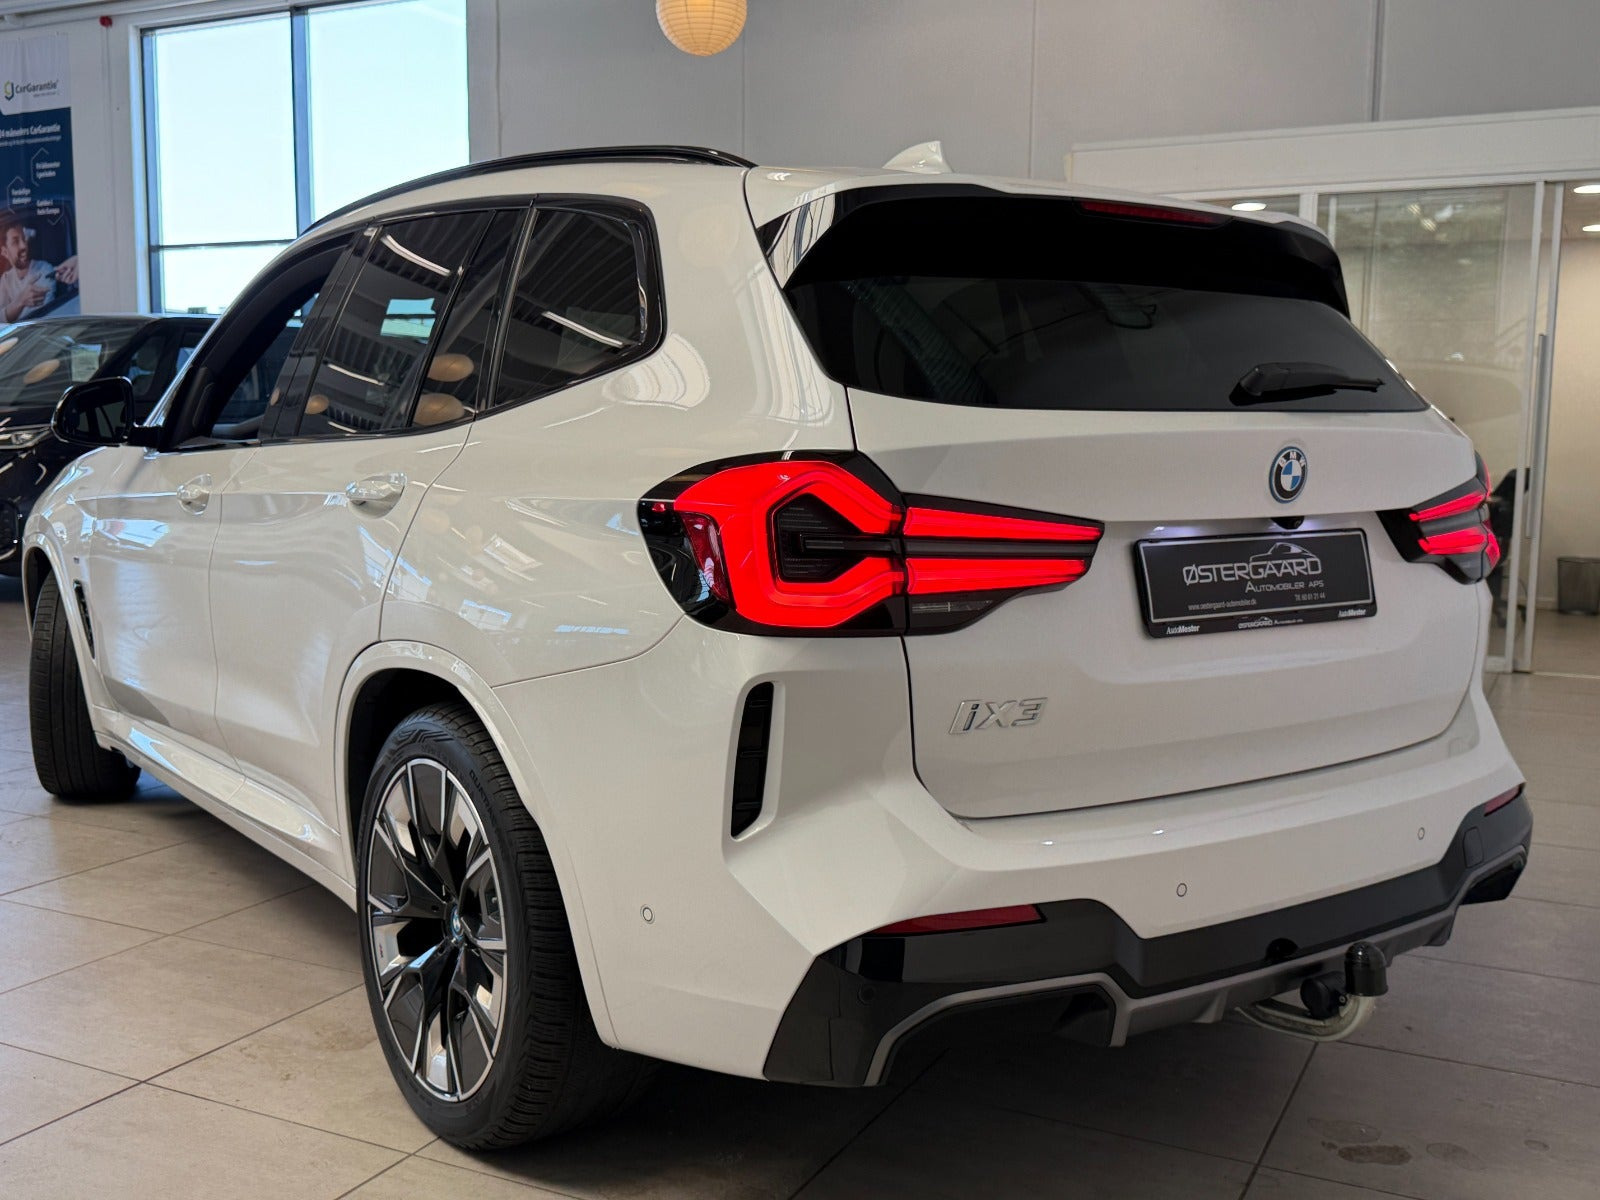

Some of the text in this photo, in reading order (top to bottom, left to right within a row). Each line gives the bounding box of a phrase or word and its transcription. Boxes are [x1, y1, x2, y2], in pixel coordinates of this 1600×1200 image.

[15, 80, 57, 94] CarGarantie
[1182, 558, 1322, 586] ØSTERGAARD
[1308, 580, 1325, 589] APS
[1166, 624, 1200, 635] AutoMester
[949, 697, 1048, 735] iX3
